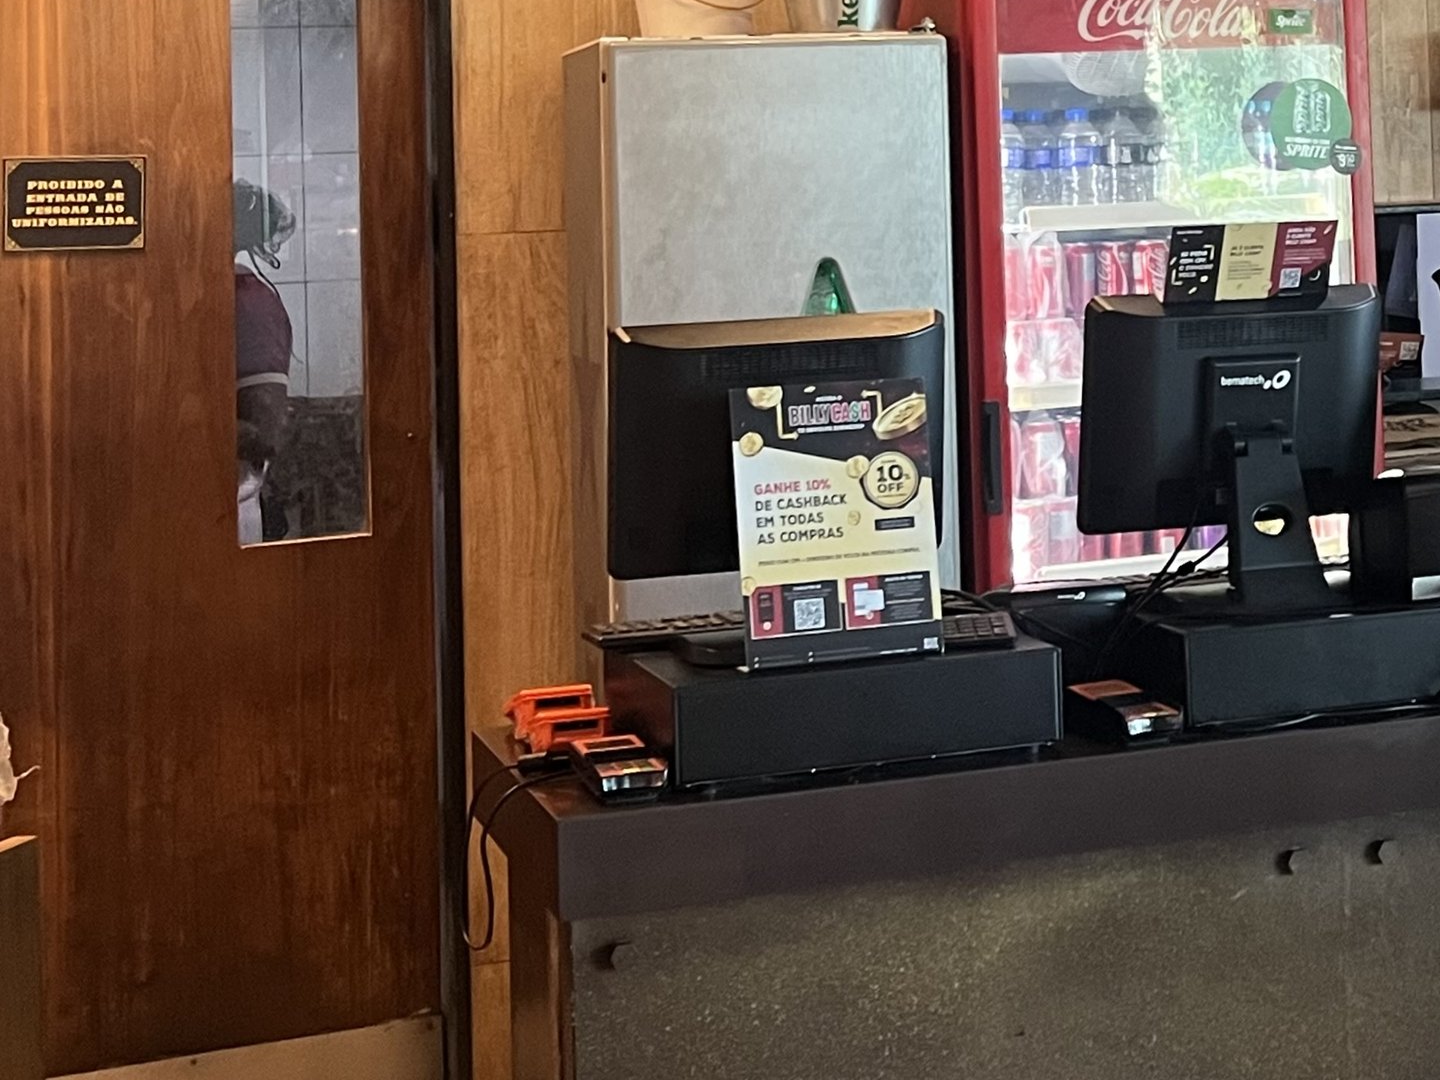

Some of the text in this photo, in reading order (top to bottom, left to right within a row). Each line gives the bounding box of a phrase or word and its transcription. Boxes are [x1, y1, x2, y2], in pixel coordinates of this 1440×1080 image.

[1275, 14, 1306, 28] Sprite
[1283, 143, 1330, 159] SPRITE
[27, 179, 123, 190] PROIBIDO A
[26, 192, 125, 203] ENTRADA DE
[25, 203, 125, 215] PESSOAS NÃO
[1221, 375, 1265, 387] bematech
[754, 478, 832, 496] GANHE 10%
[877, 483, 905, 494] OFF
[755, 493, 848, 512] DE CASHBACK
[756, 511, 825, 529] EM TODAS
[757, 526, 845, 546] AS COMPRAS
